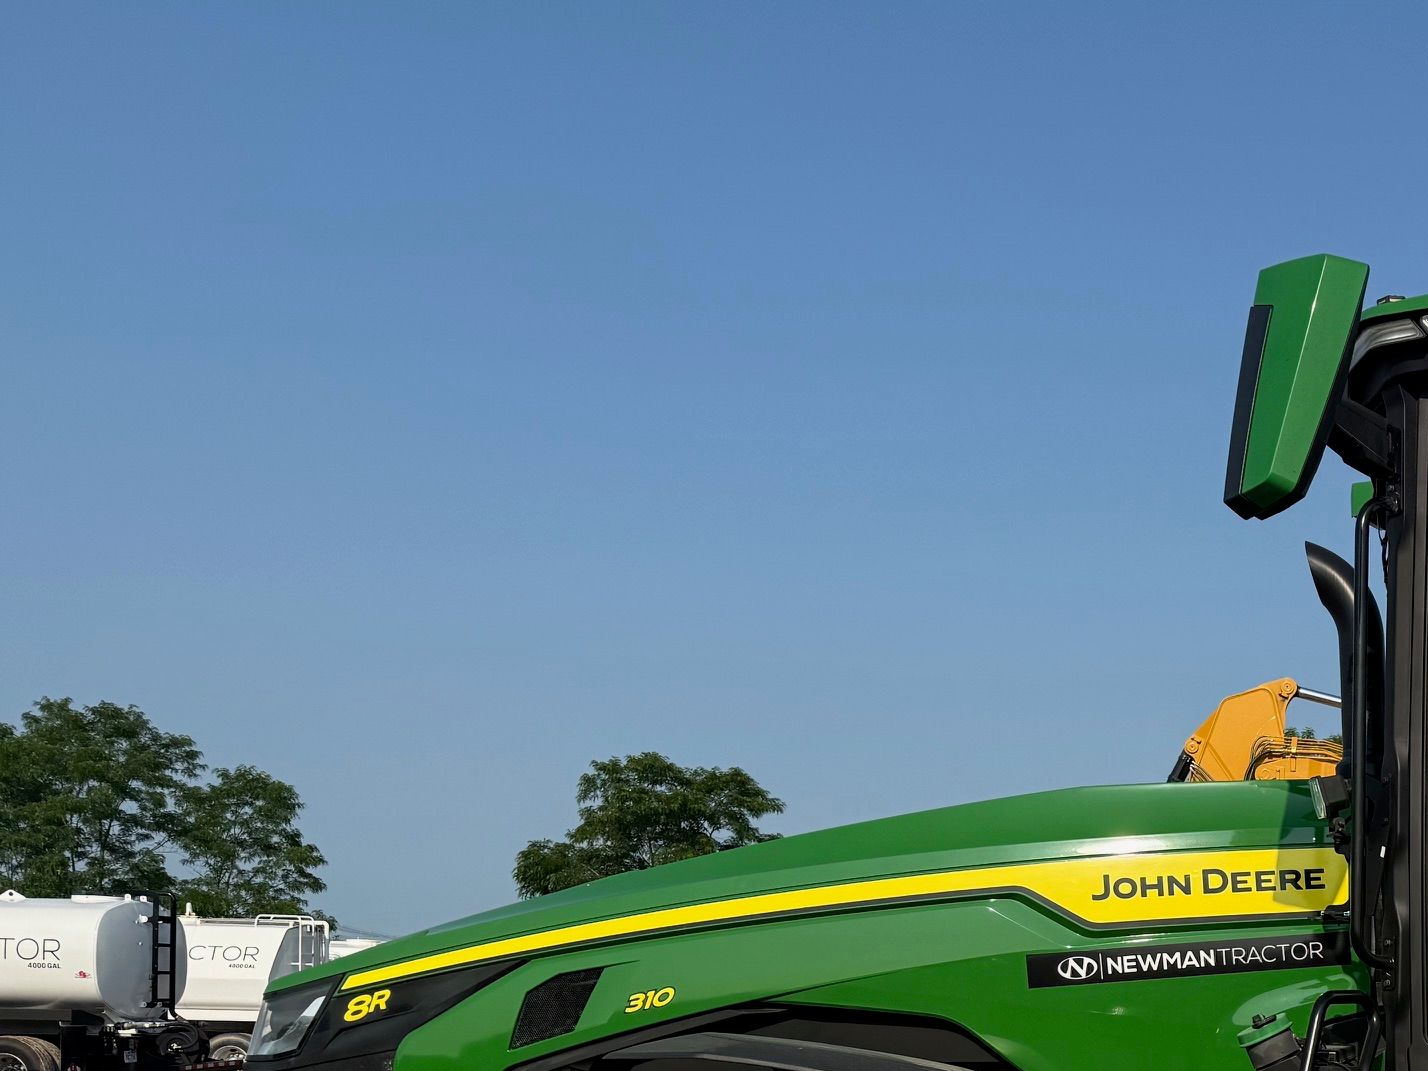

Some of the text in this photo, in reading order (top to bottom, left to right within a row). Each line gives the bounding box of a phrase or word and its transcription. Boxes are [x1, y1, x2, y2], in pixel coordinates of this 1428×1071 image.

[1091, 868, 1326, 902] JOHN DEERE
[343, 989, 392, 1023] 8R
[624, 986, 676, 1014] 310
